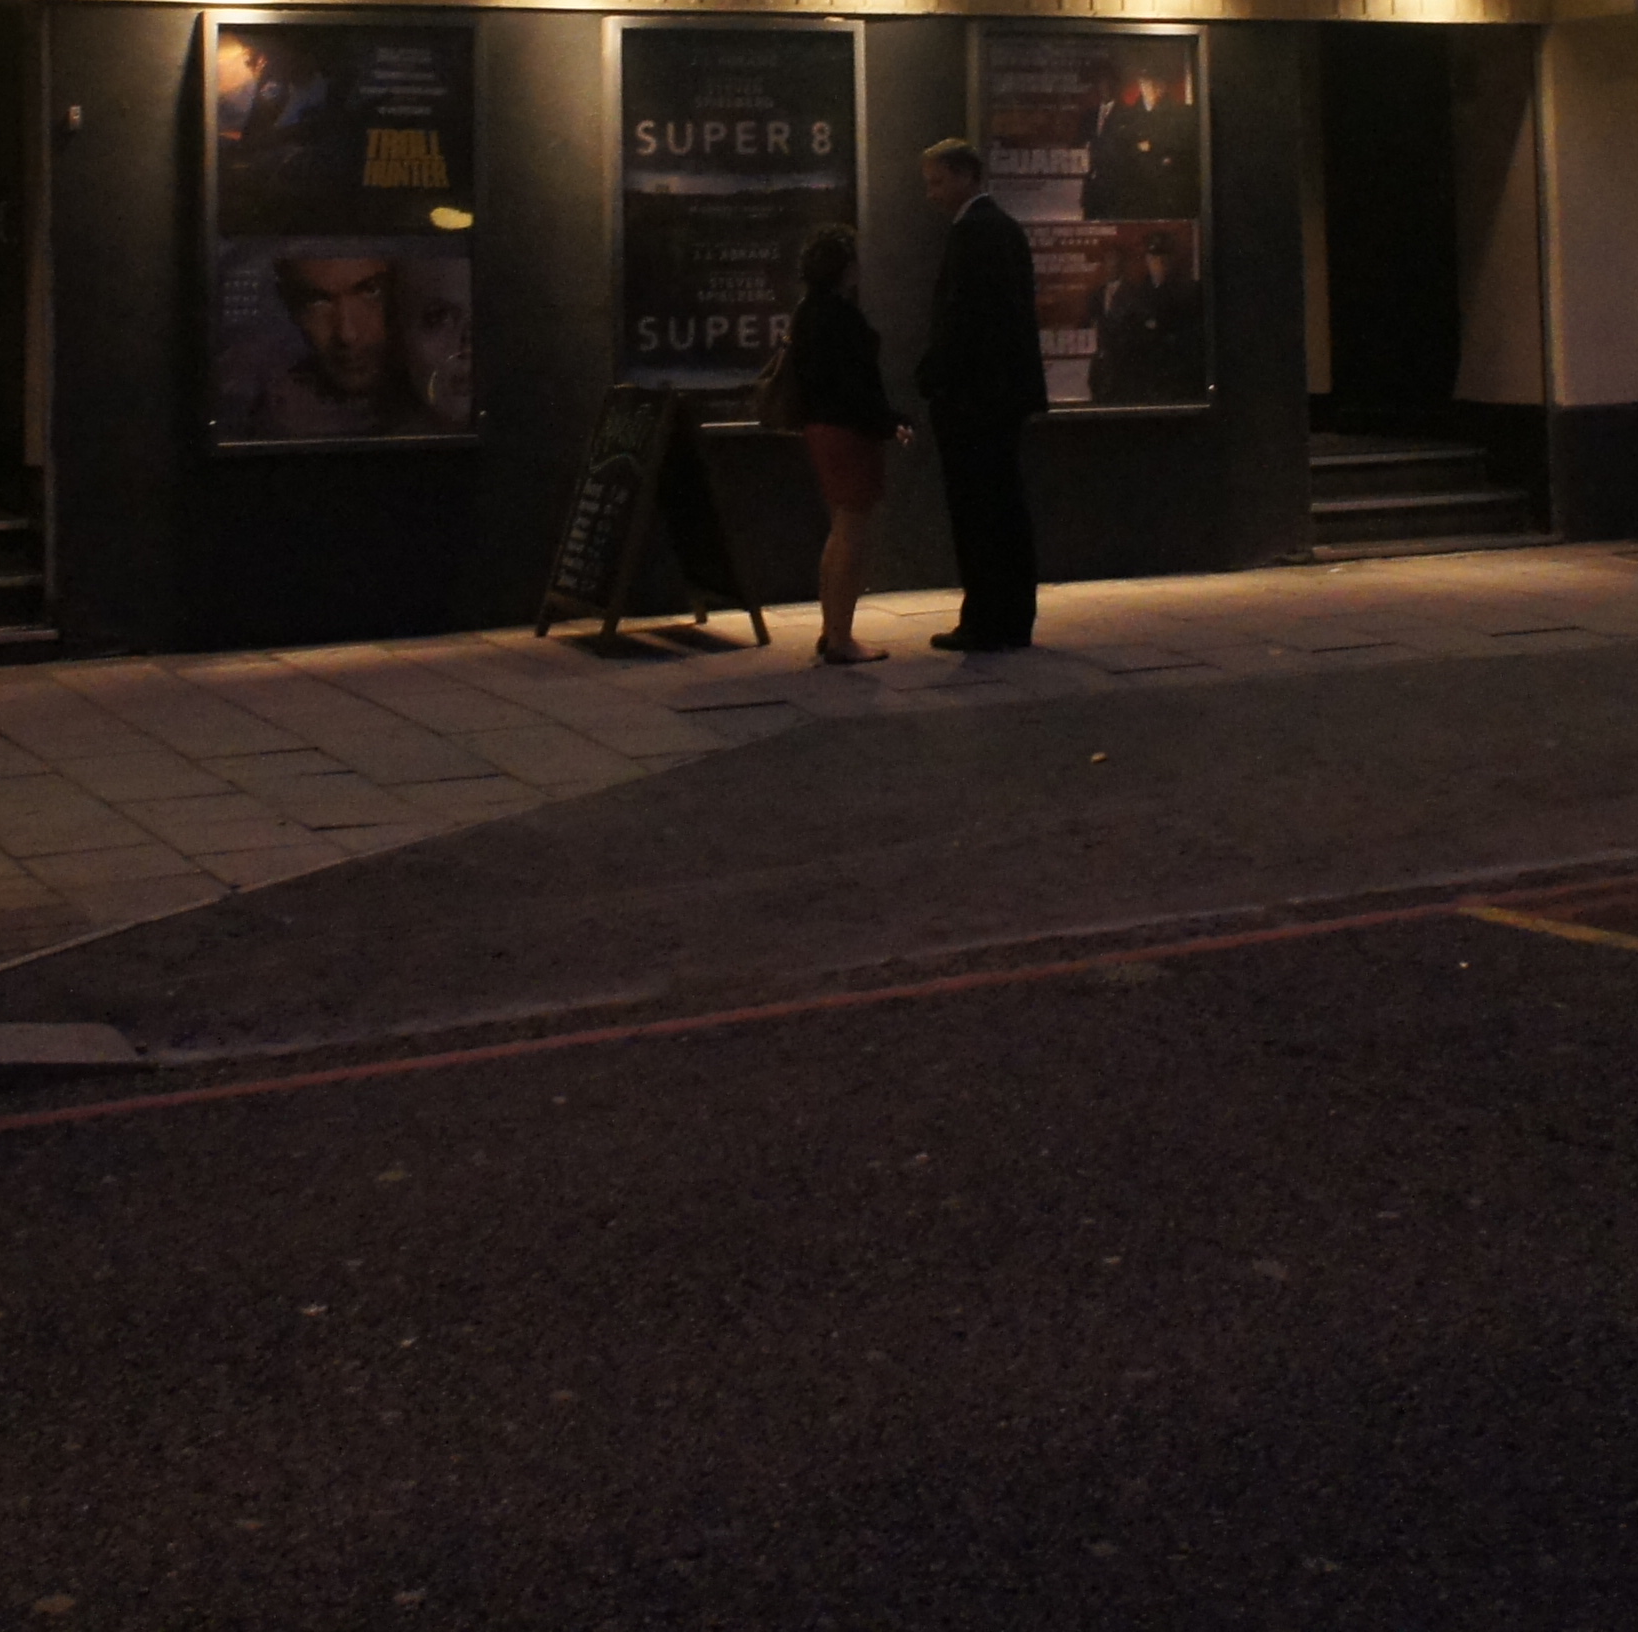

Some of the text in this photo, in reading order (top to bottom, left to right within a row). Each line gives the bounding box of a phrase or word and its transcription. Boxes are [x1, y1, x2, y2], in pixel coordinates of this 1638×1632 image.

[635, 120, 832, 156] SUPER 8
[638, 315, 791, 352] SUPER
